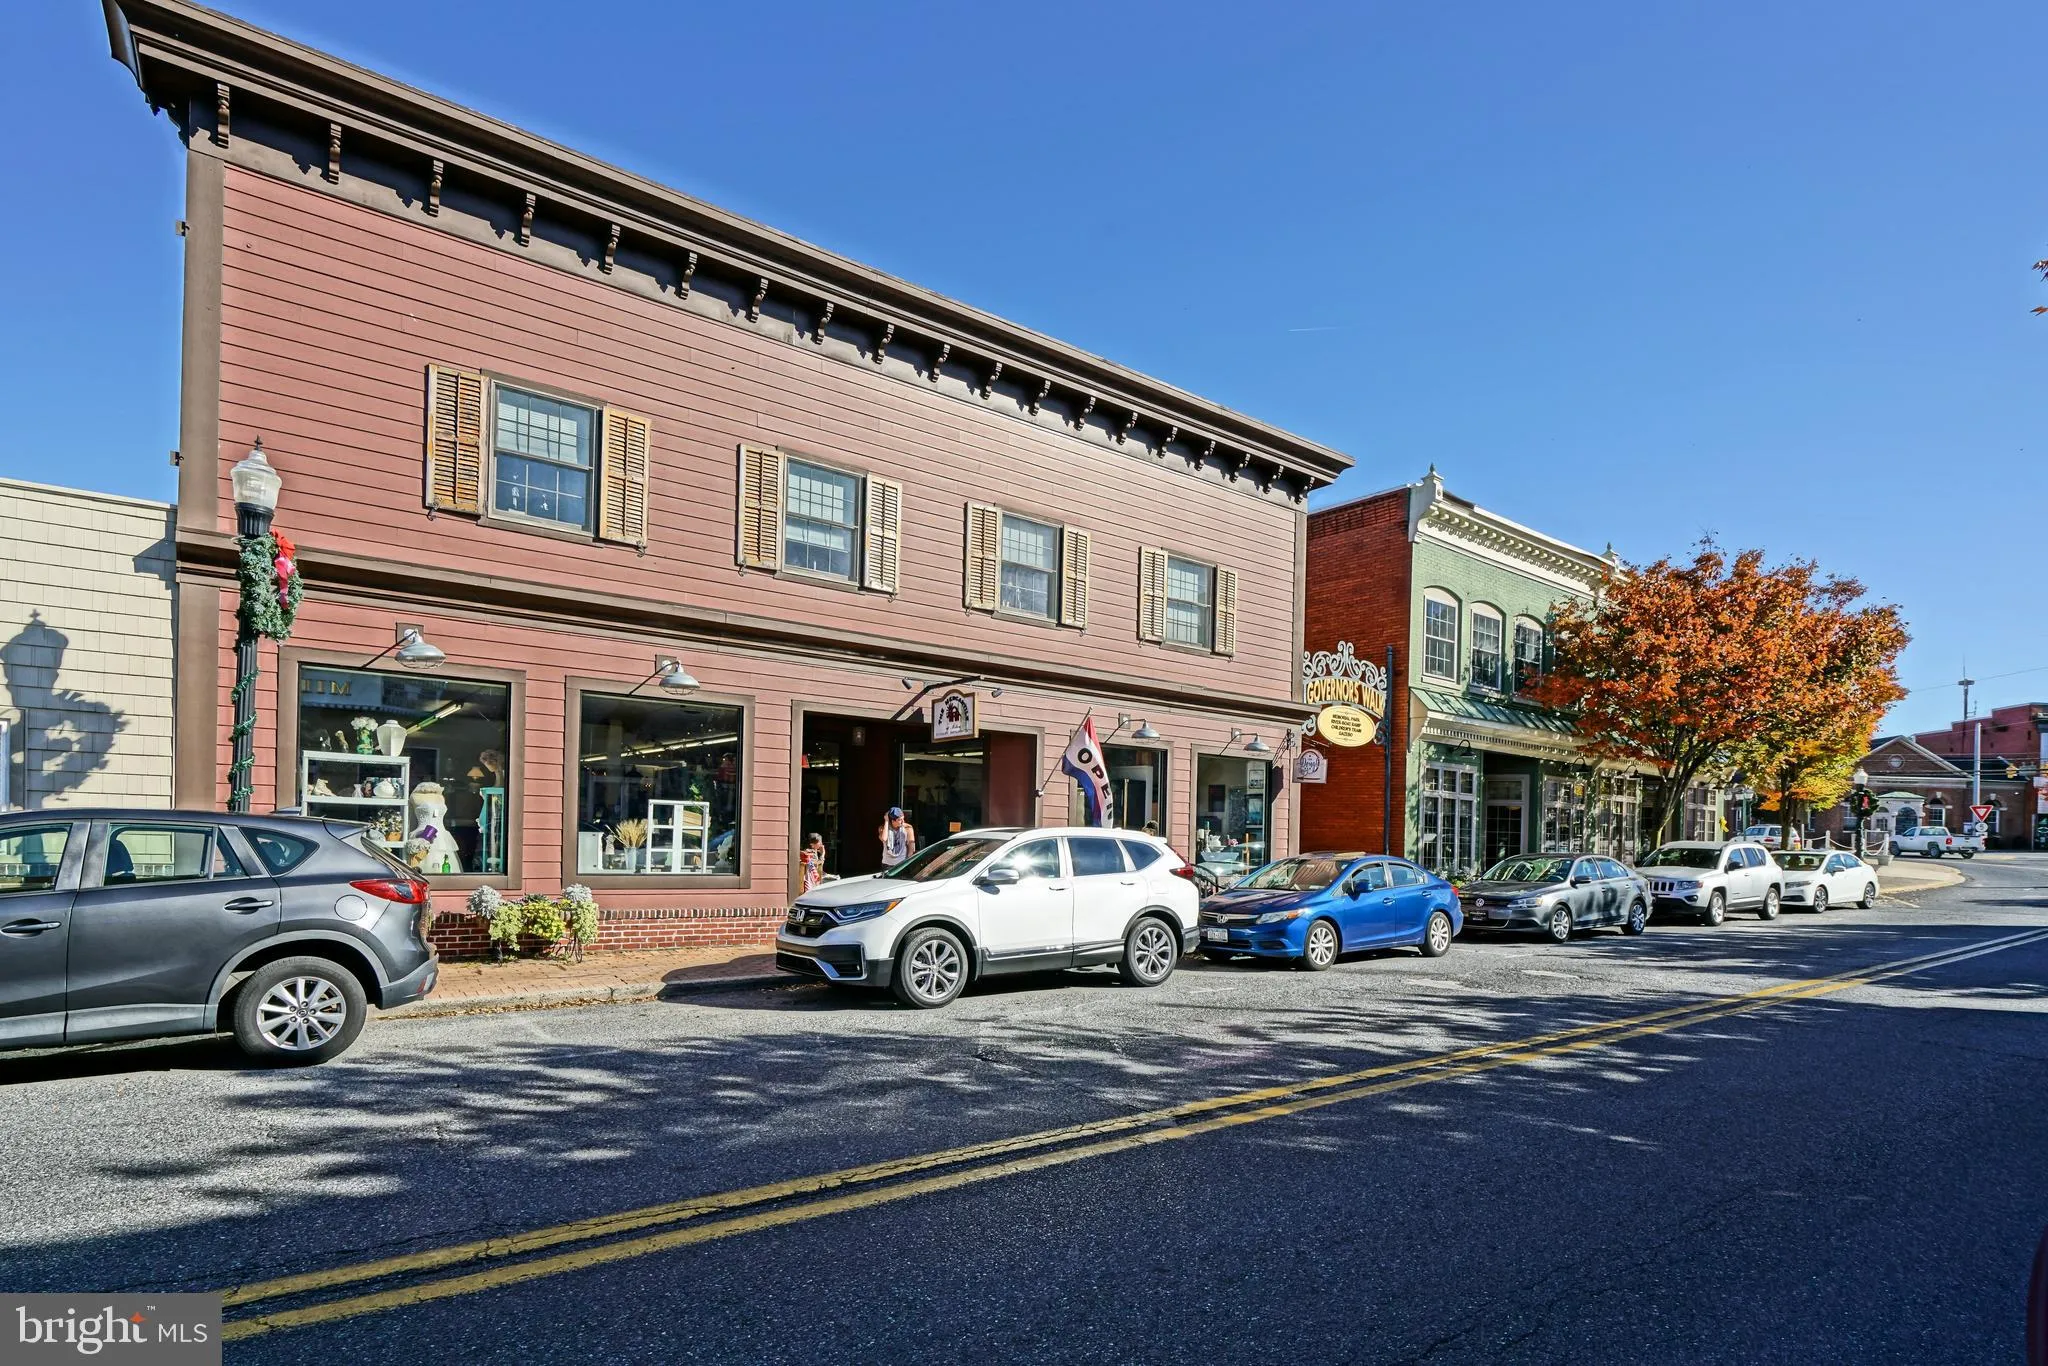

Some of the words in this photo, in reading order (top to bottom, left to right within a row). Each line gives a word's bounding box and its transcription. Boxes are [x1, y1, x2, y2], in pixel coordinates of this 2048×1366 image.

[944, 695, 969, 722] MERCANTILE
[1307, 679, 1359, 704] GOVERNORS
[1361, 685, 1385, 717] WALK
